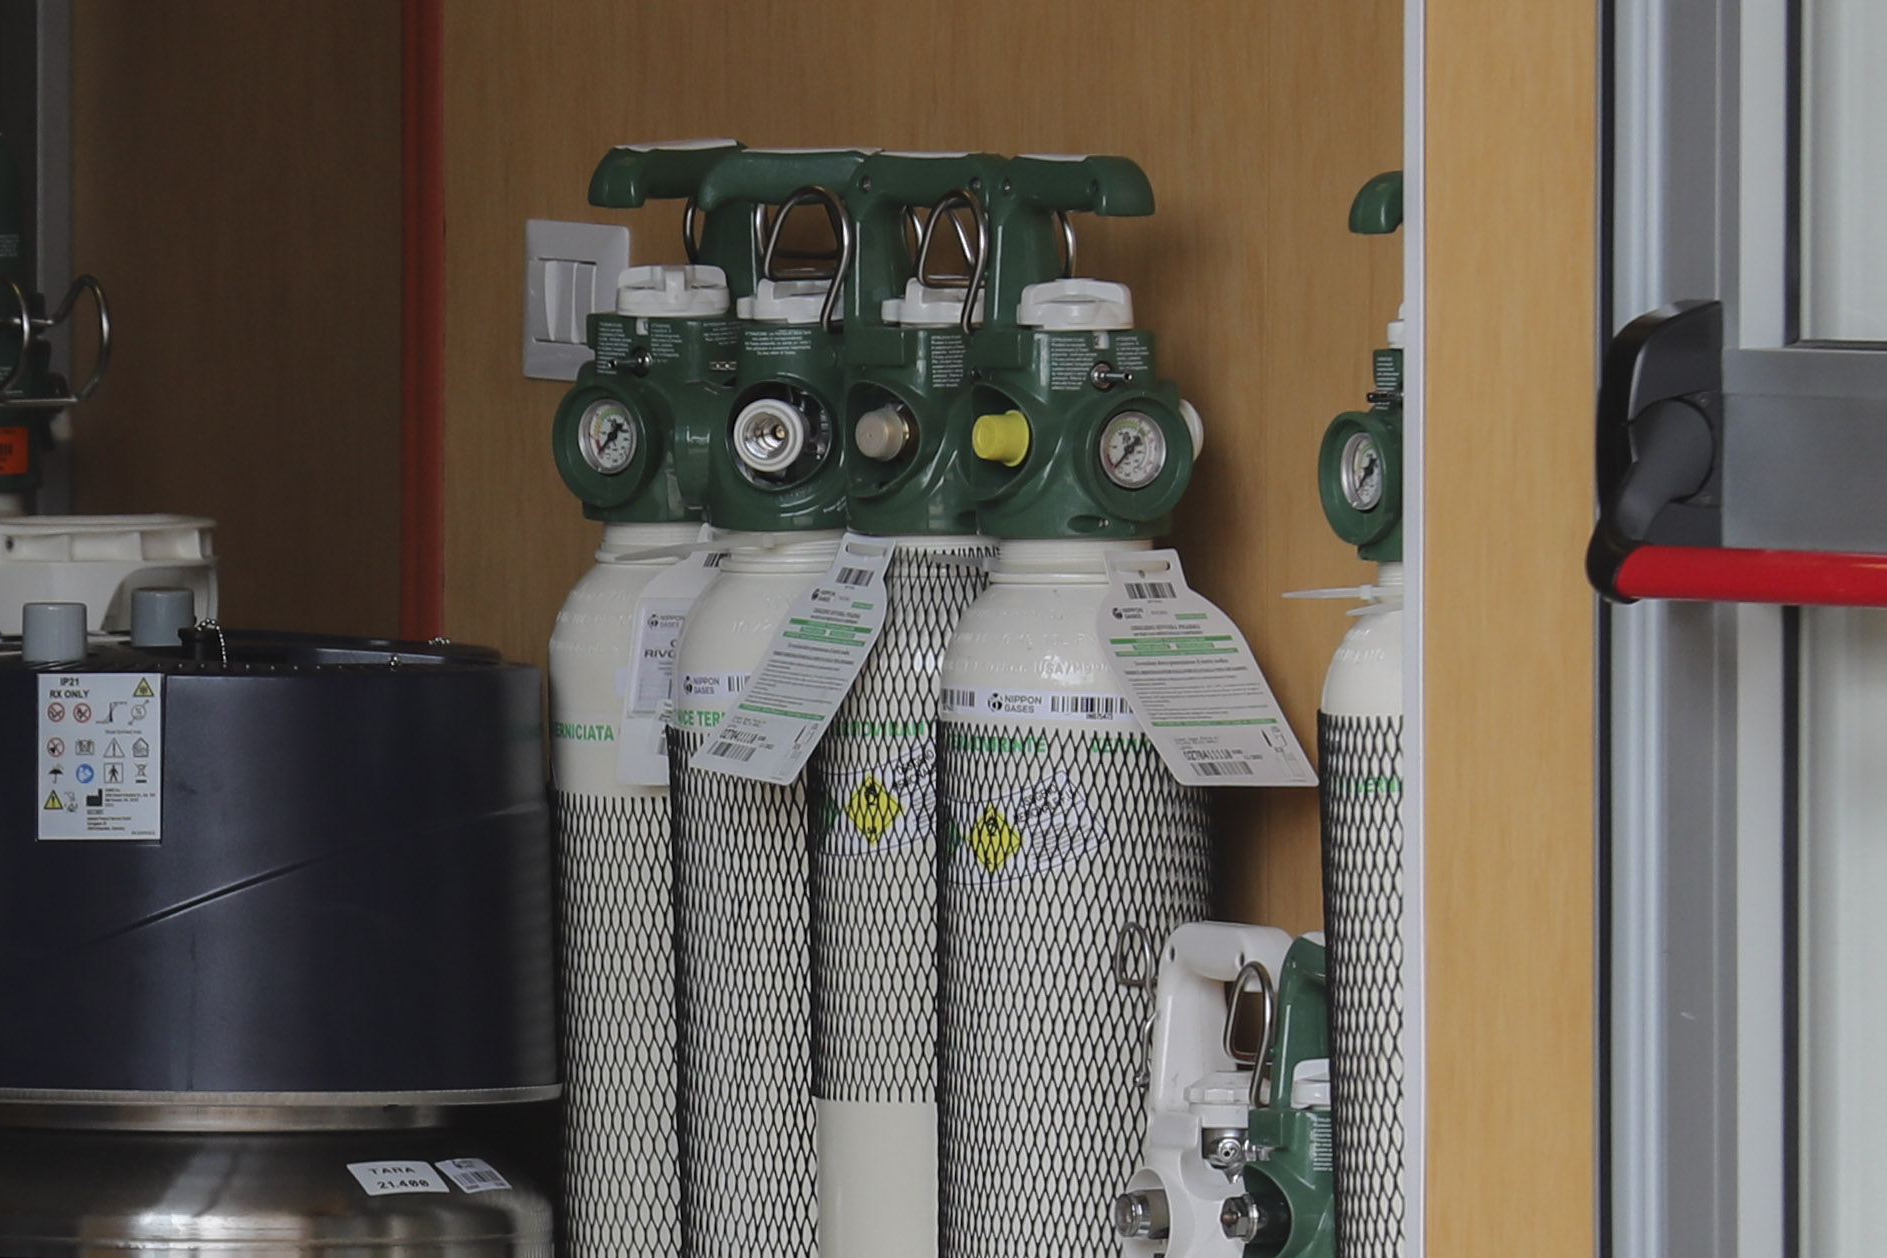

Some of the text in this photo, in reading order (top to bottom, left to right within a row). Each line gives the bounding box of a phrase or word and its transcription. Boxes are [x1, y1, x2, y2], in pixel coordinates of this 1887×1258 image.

[60, 678, 79, 686] IP21
[49, 690, 90, 698] RX ONLY
[1004, 695, 1042, 705] NIPPON
[1004, 705, 1035, 713] GASES
[697, 710, 726, 727] TER
[369, 1166, 416, 1176] TARA
